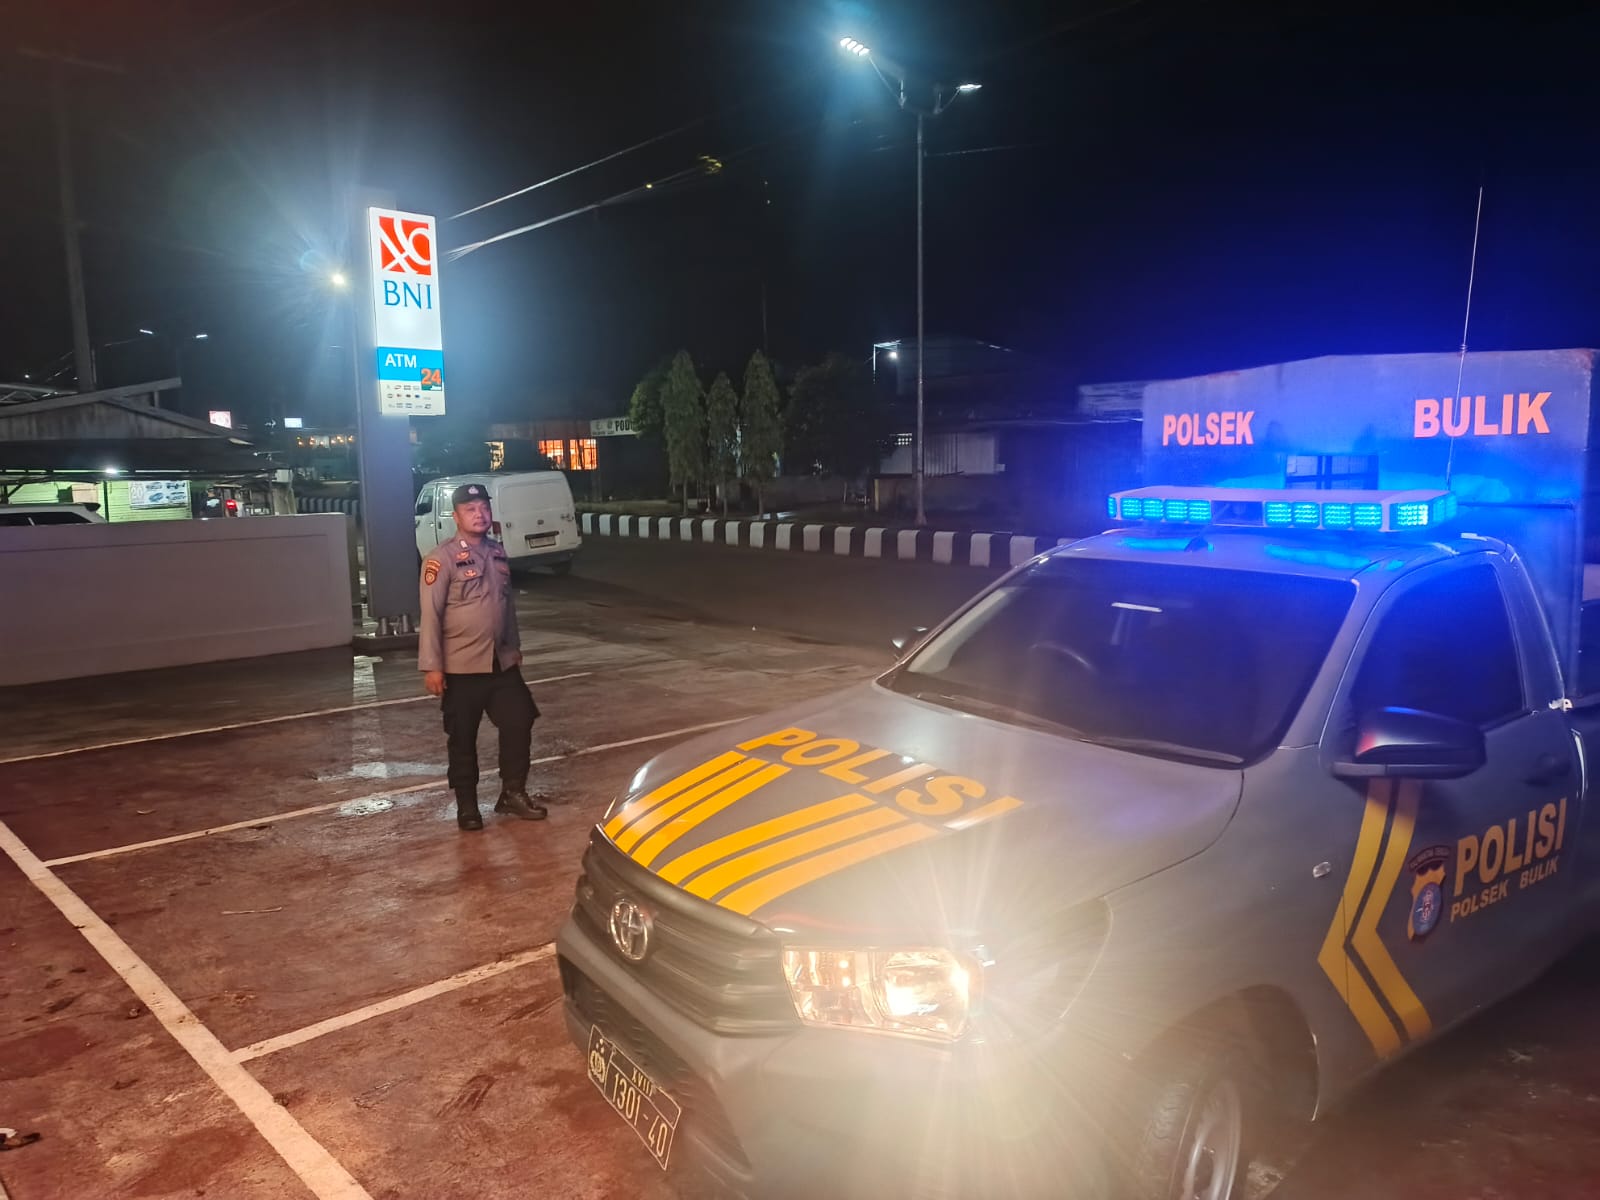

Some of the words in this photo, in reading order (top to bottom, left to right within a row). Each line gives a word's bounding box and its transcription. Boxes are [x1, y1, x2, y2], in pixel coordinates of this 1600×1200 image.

[383, 279, 433, 310] BNI
[385, 353, 418, 369] ATM
[420, 367, 442, 385] 24
[1162, 410, 1255, 447] POLSEK
[1413, 391, 1553, 438] BULIK
[735, 726, 1025, 831] POLISI
[1453, 797, 1568, 897] POLISI
[1449, 878, 1509, 923] POLSEK
[1519, 855, 1560, 890] BULIK
